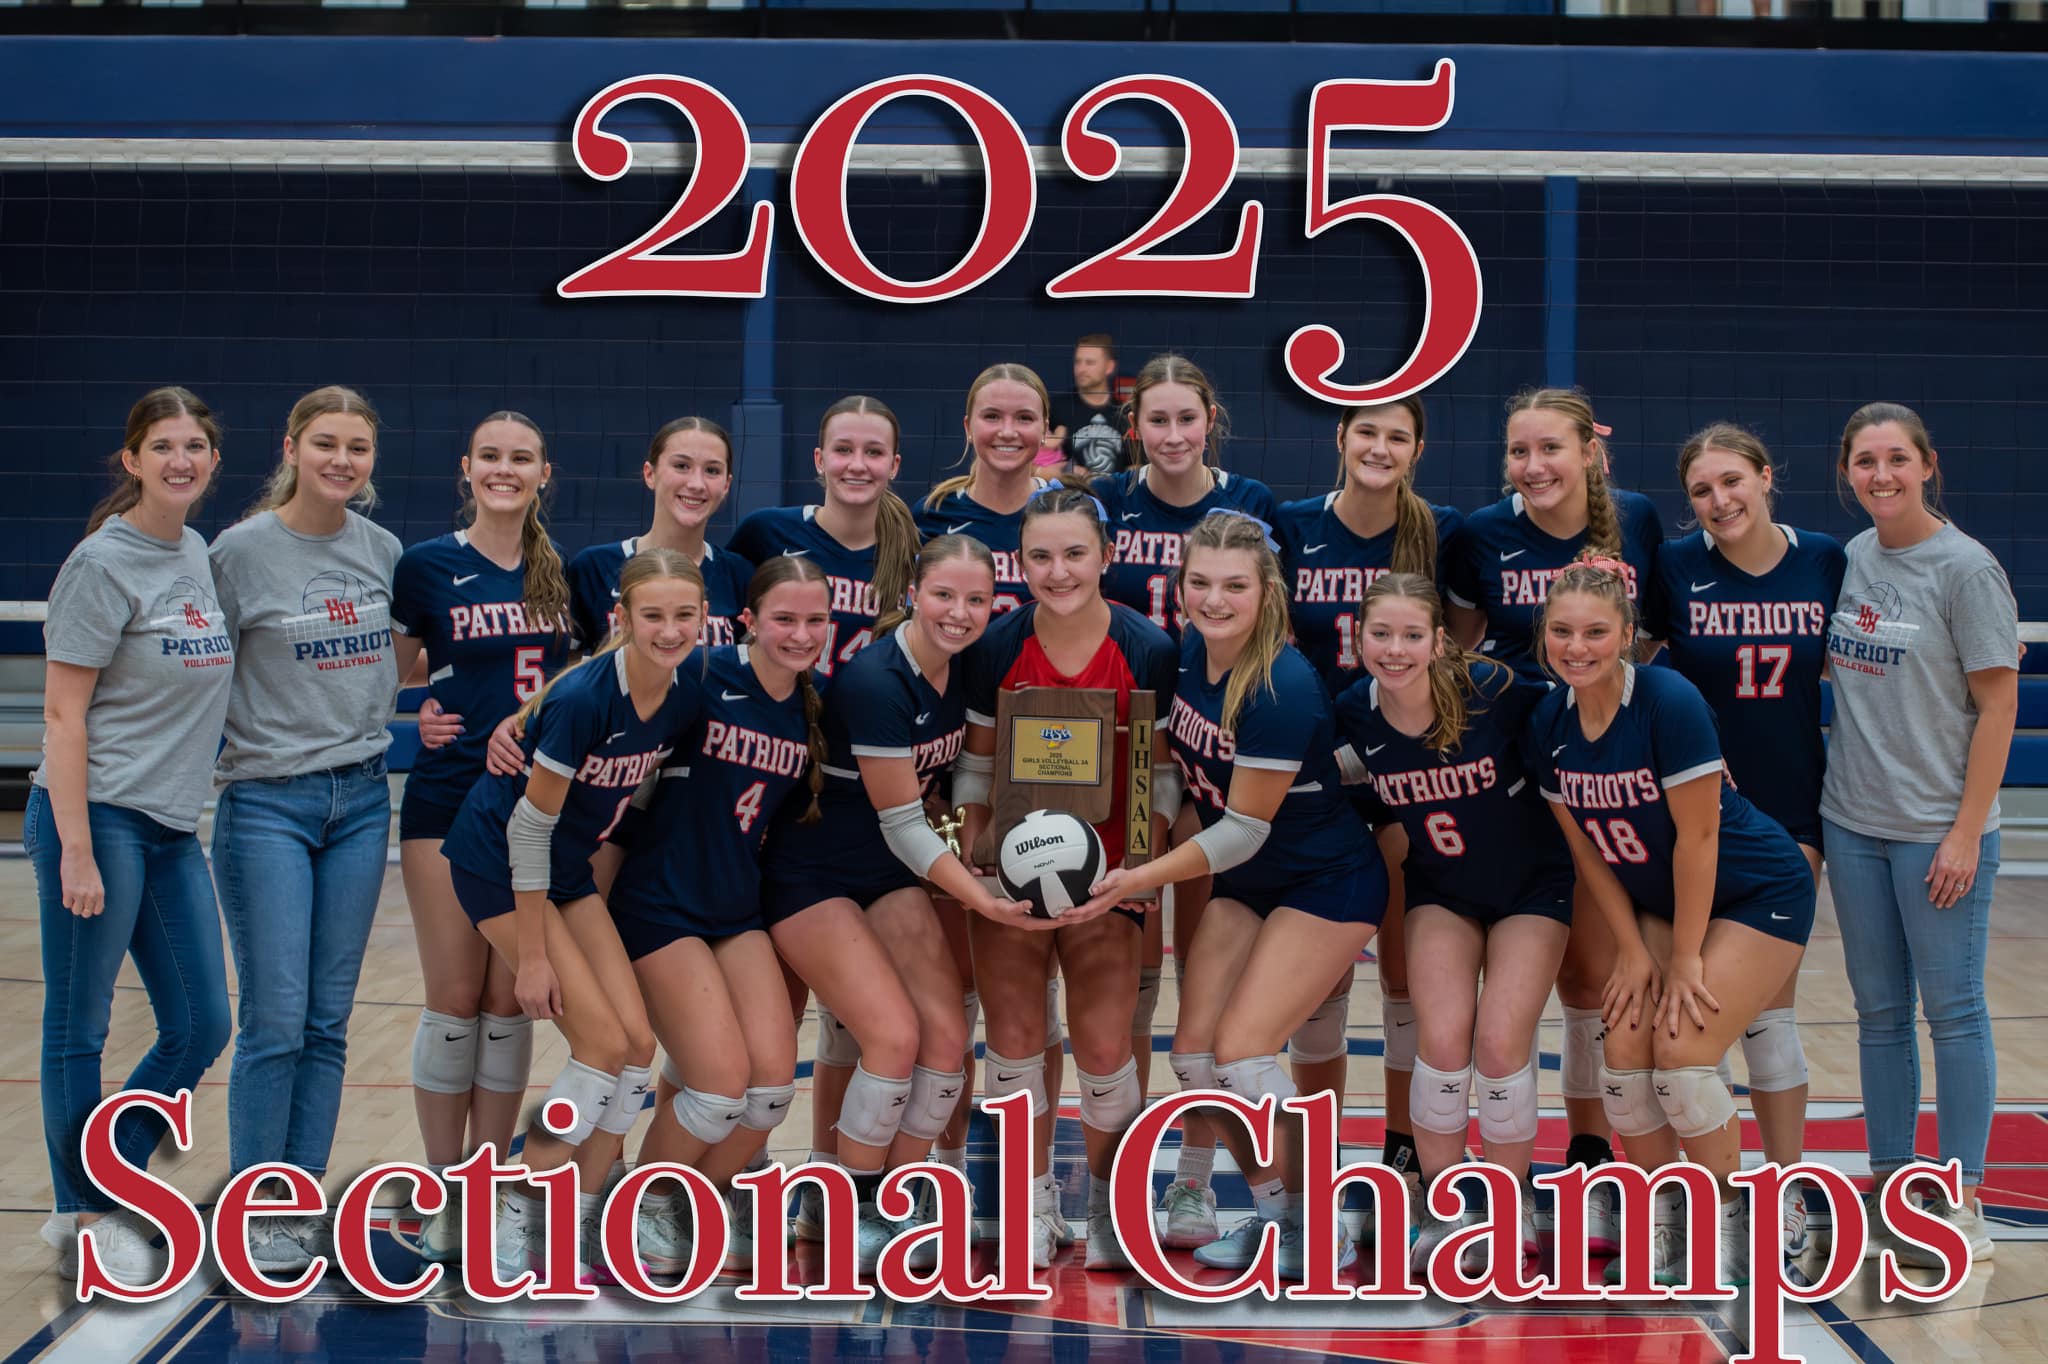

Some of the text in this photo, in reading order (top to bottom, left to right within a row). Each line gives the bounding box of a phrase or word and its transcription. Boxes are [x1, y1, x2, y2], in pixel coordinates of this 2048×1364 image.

[1688, 600, 1825, 637] PATRIOTS
[161, 635, 232, 656] PATRIO
[183, 655, 232, 668] VOLLEYBALL
[317, 653, 383, 671] VOLLEYBALL
[1831, 655, 1886, 677] VOLLEYBALL
[514, 646, 545, 706] 5
[1735, 643, 1792, 699] 17
[702, 719, 810, 779] PATRIOT
[734, 780, 768, 834] 4
[1554, 767, 1660, 809] ATRIOTS
[1015, 834, 1065, 856] Wilson
[1424, 811, 1467, 857] 6
[1584, 817, 1649, 865] 18
